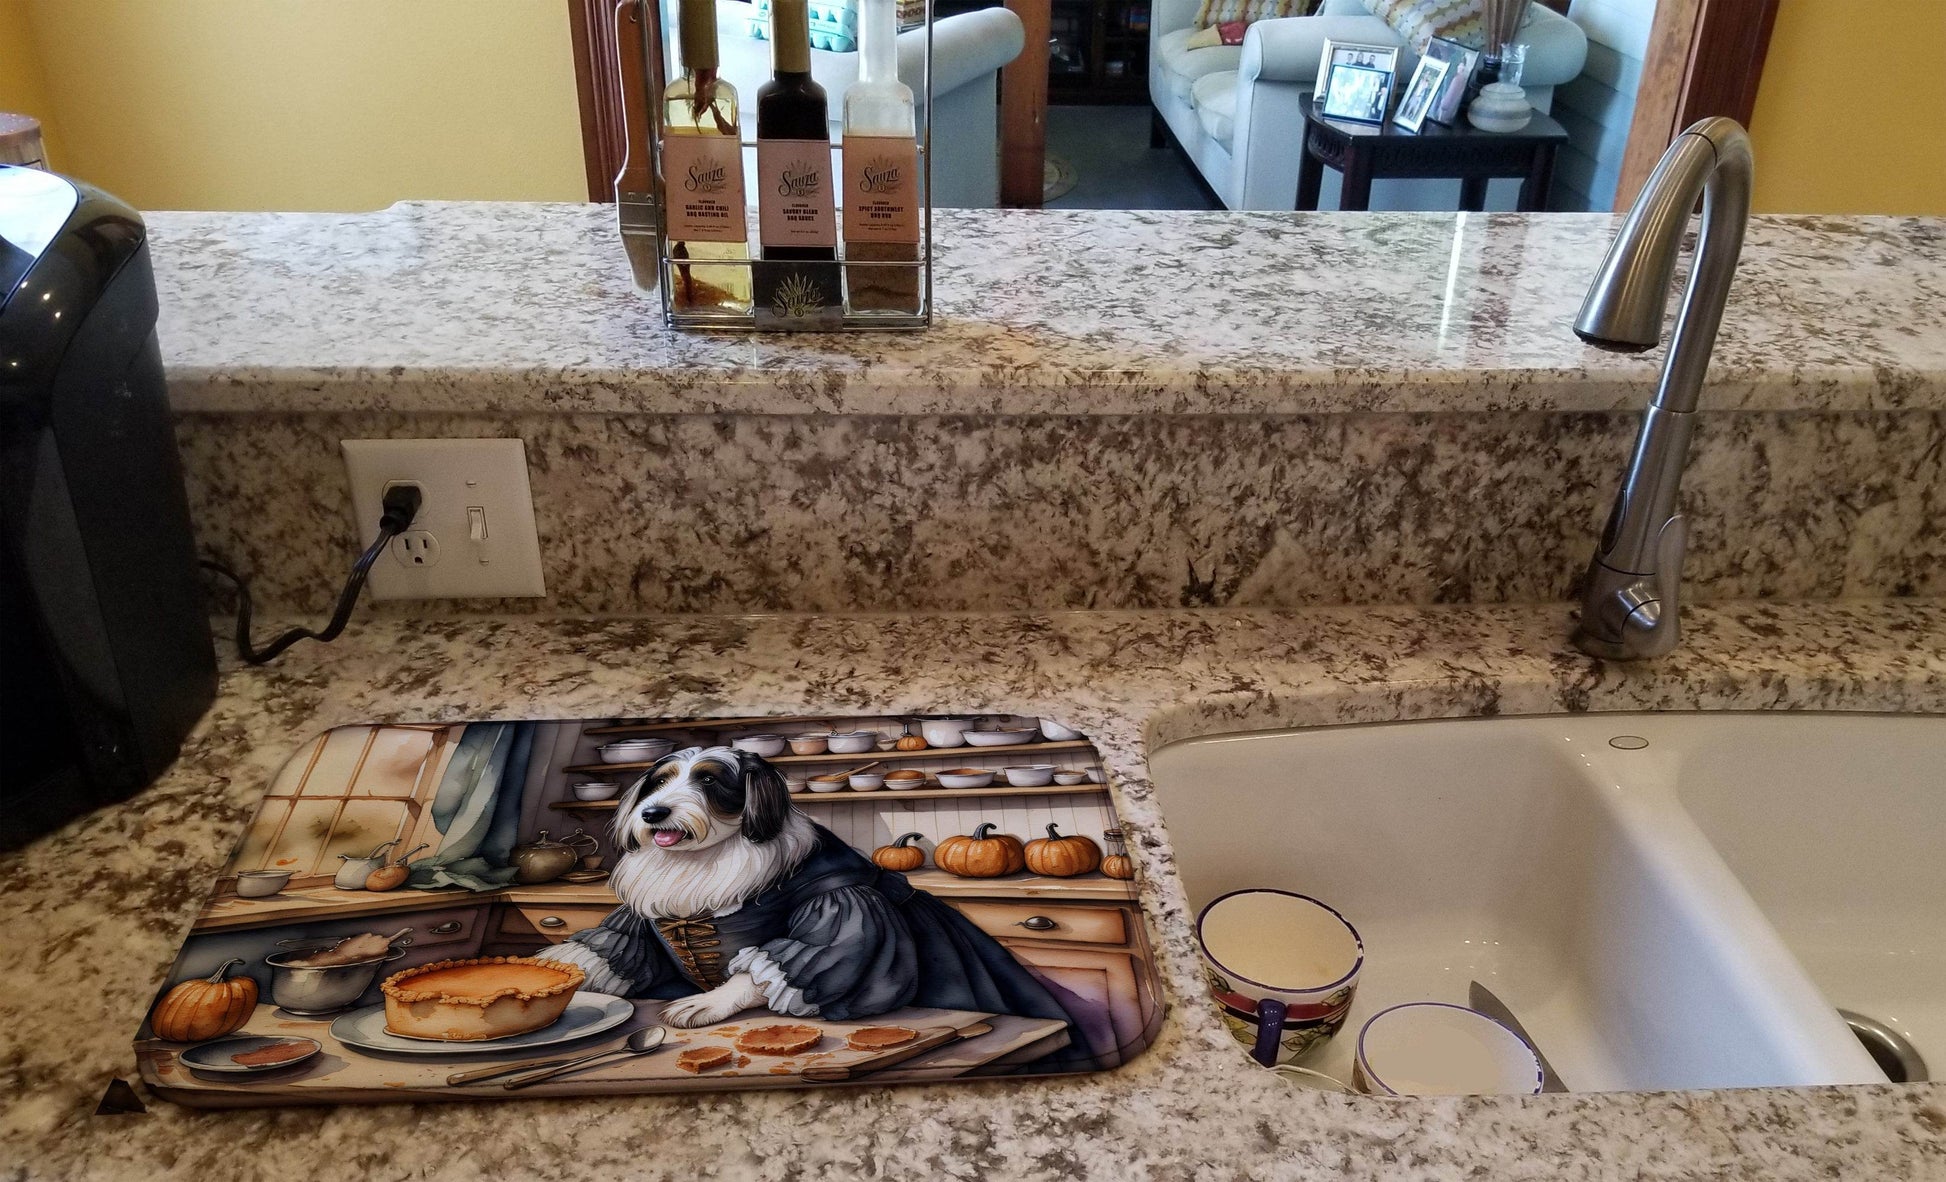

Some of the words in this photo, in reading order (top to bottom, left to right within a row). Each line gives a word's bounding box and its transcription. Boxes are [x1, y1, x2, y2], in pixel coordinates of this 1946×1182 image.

[684, 166, 726, 192] Sauza
[778, 171, 819, 197] Sauza
[860, 166, 899, 193] Sauza
